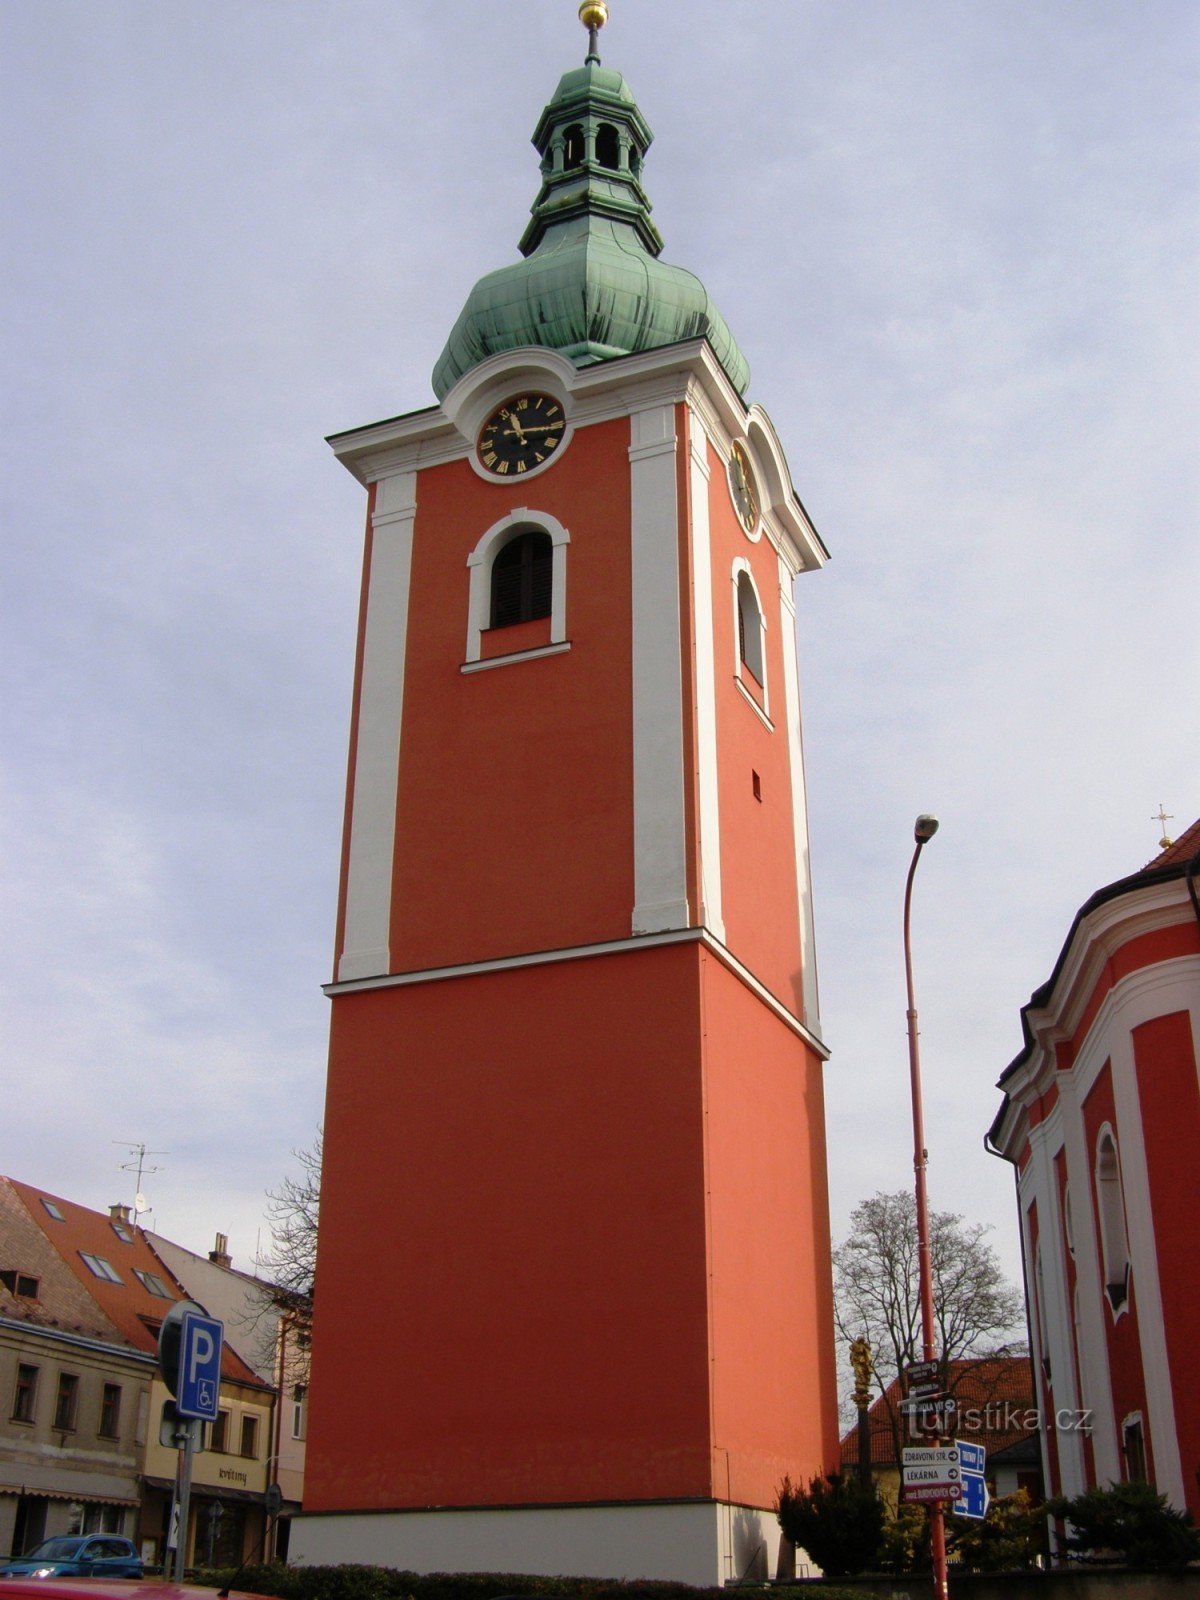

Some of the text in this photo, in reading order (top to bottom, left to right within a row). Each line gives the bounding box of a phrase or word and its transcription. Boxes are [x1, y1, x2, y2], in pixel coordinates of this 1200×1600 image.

[189, 1327, 214, 1384] P
[905, 1450, 935, 1461] ZDRAVOTNÍ
[219, 1467, 247, 1487] květiny
[907, 1469, 939, 1481] LÉKÁRNA
